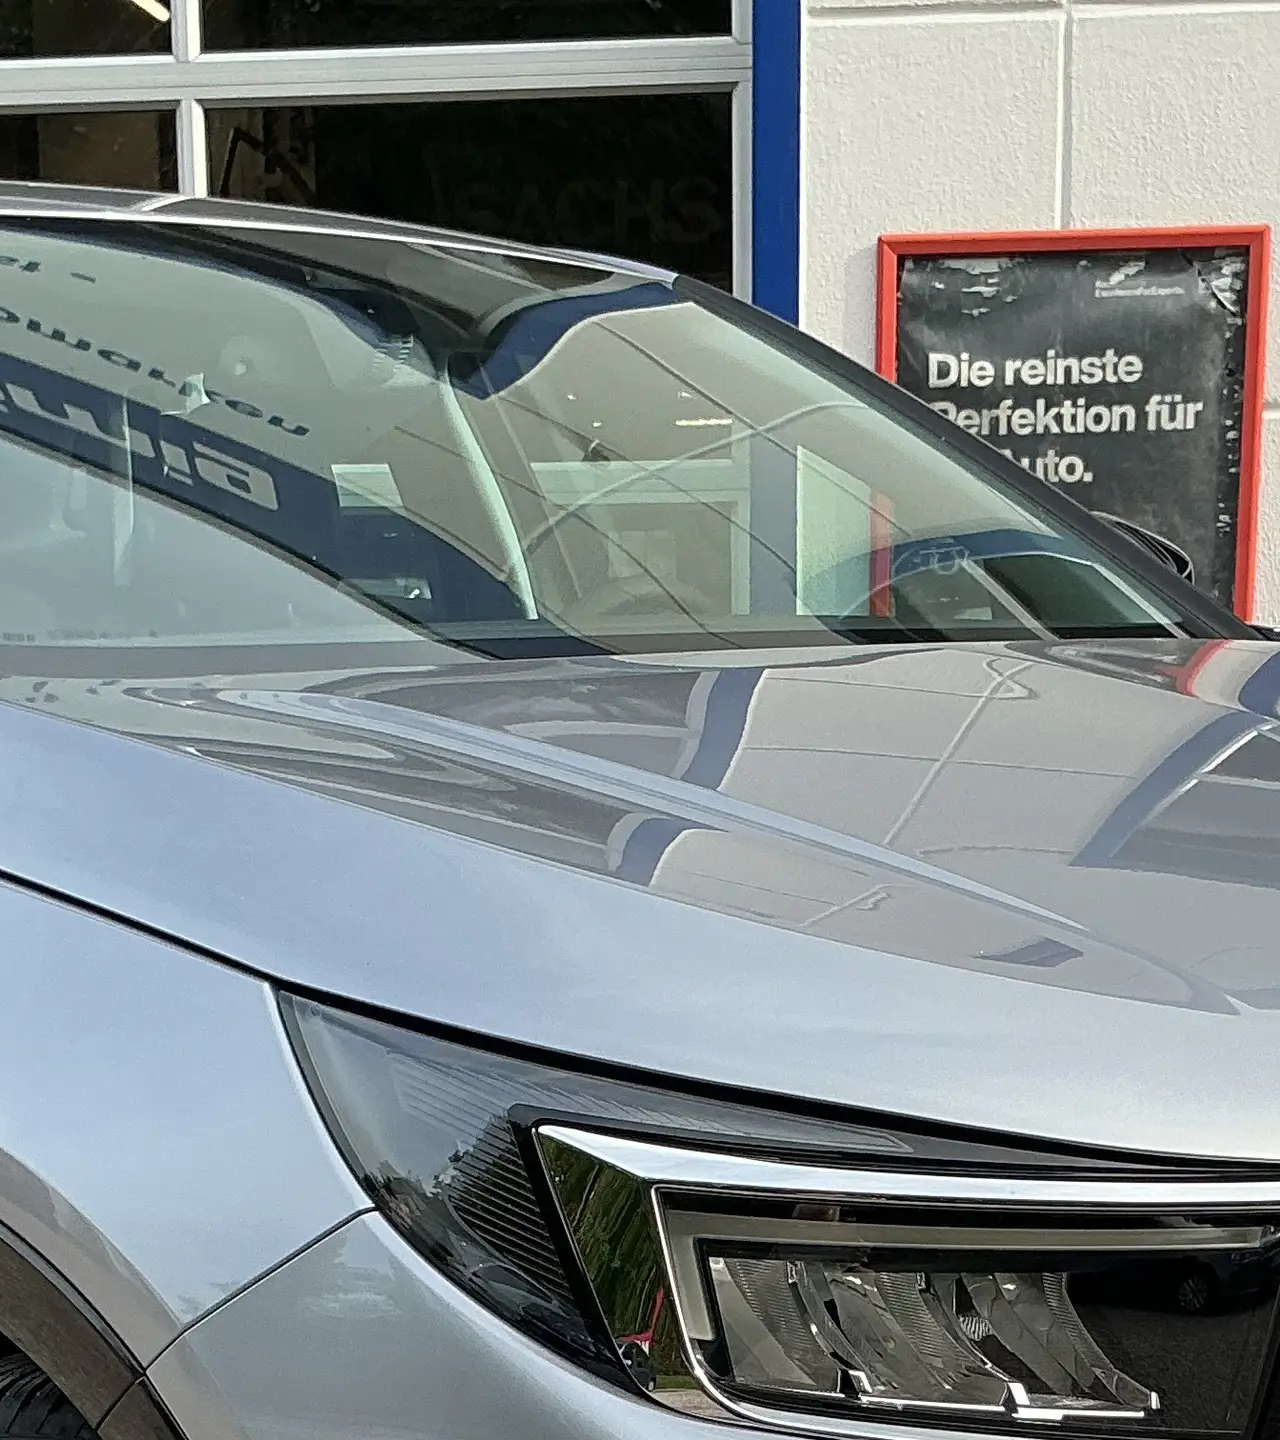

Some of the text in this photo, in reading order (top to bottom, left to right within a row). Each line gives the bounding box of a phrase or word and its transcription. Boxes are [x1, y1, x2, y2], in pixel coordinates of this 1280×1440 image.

[927, 348, 1144, 388] Die reinste
[1145, 394, 1204, 431] für
[1000, 448, 1094, 483] uto.
